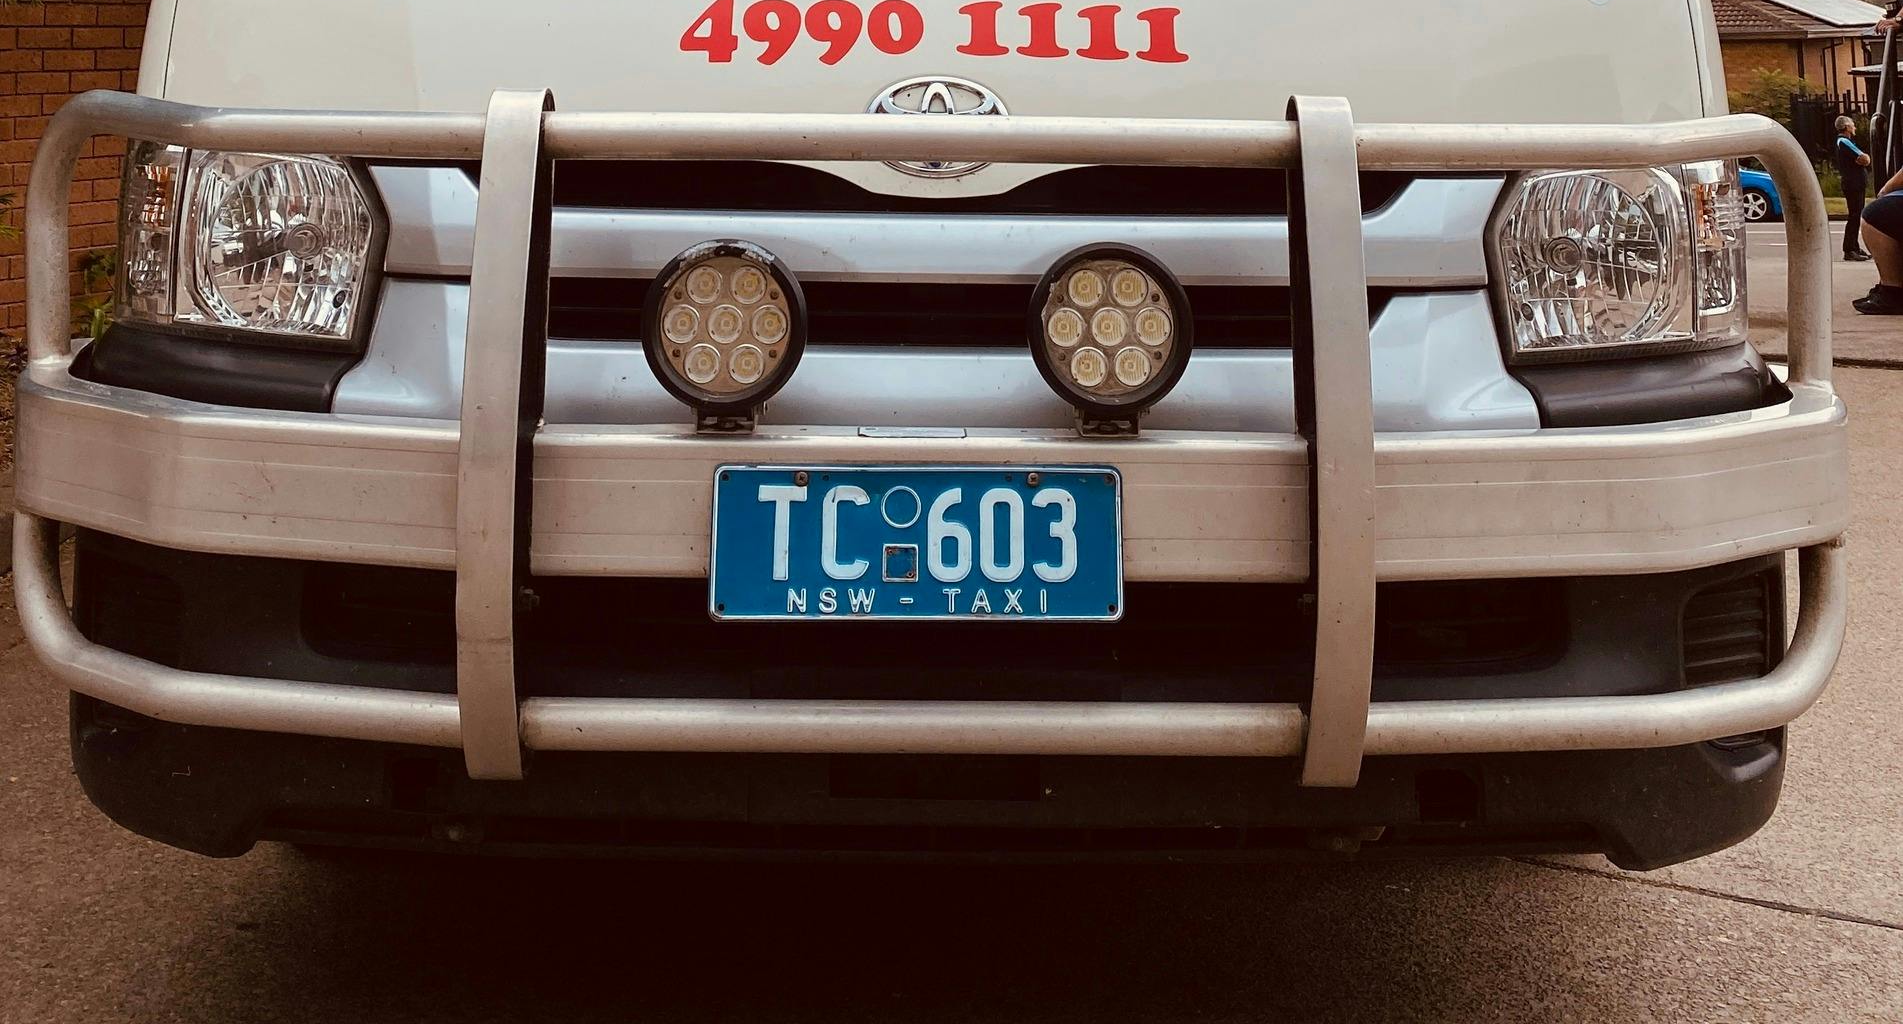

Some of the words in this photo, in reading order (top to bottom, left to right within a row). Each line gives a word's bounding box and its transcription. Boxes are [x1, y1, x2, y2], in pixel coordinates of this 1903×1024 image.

[956, 0, 1190, 64] 1111
[787, 588, 876, 614] NSW
[942, 588, 1048, 614] TAXI
